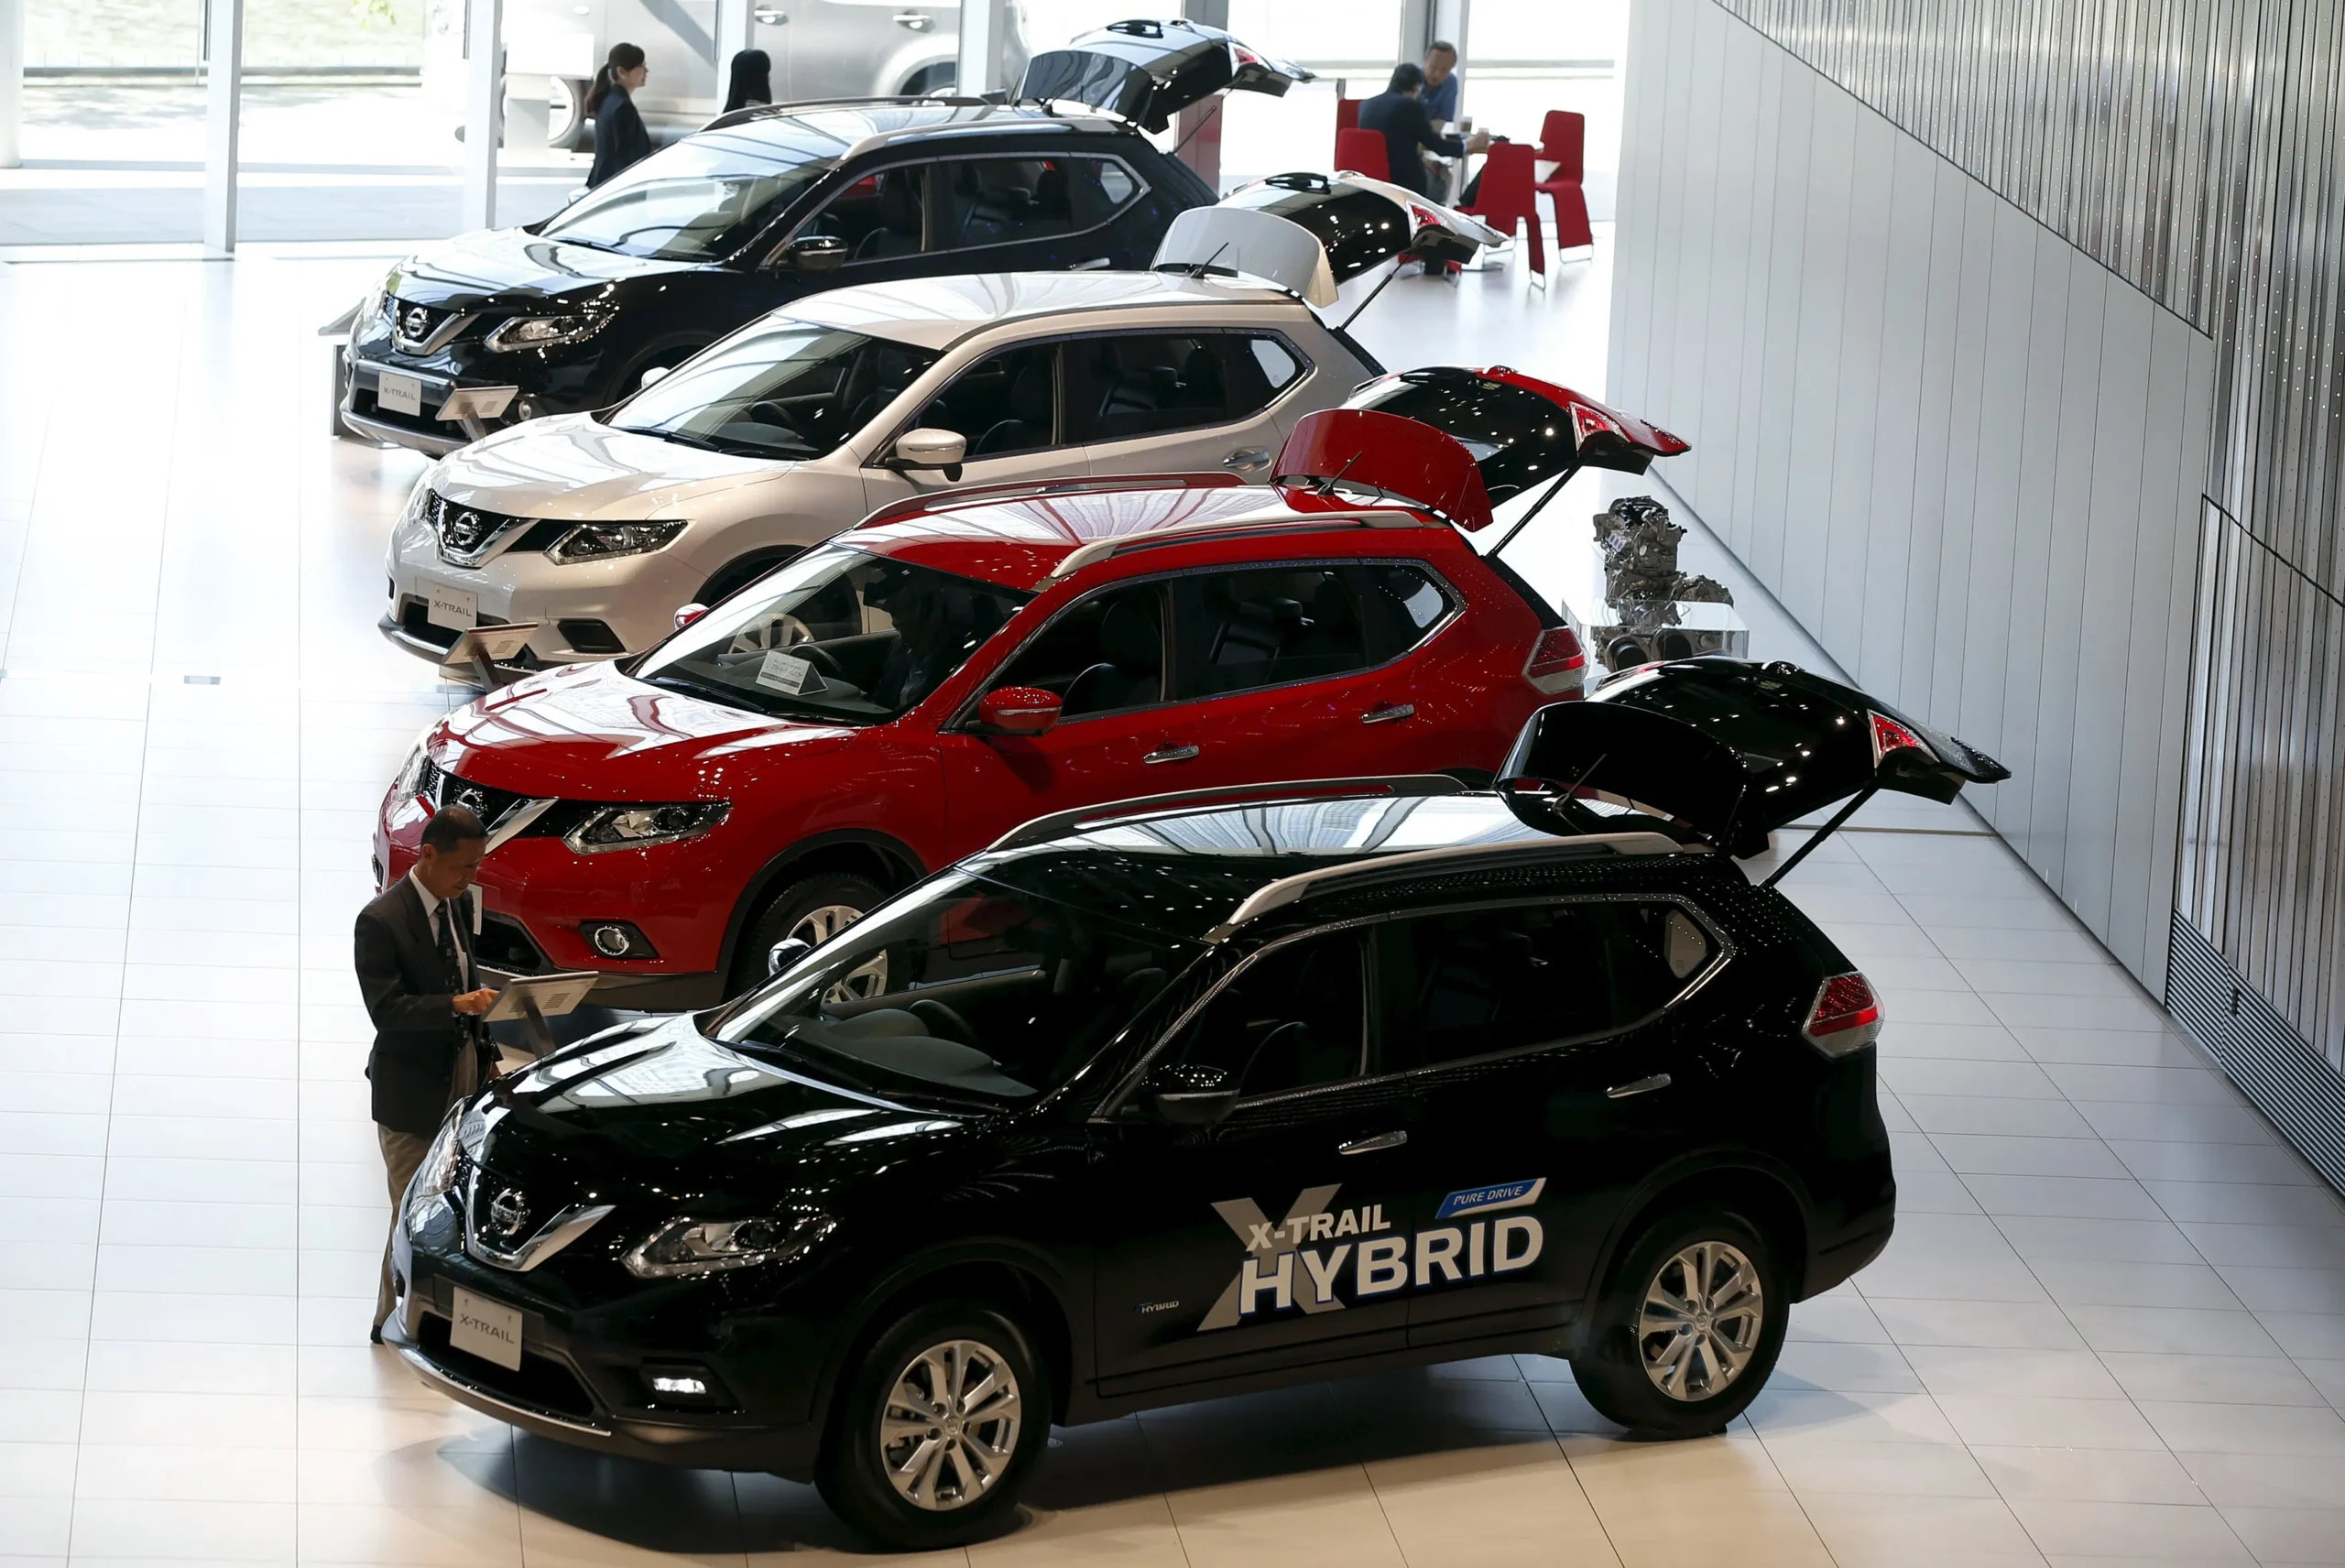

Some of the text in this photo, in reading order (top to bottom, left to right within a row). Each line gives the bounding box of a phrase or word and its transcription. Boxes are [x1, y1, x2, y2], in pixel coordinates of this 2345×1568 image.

[384, 387, 416, 400] X-TRAIL
[434, 600, 472, 617] X-TRAIL
[1453, 1186, 1523, 1206] PURE DRIVE
[1246, 1204, 1391, 1252] X-TRAIL
[1239, 1215, 1544, 1314] HYBRID
[1141, 1301, 1179, 1314] HYBRID
[460, 1312, 515, 1345] X-TRAIL
